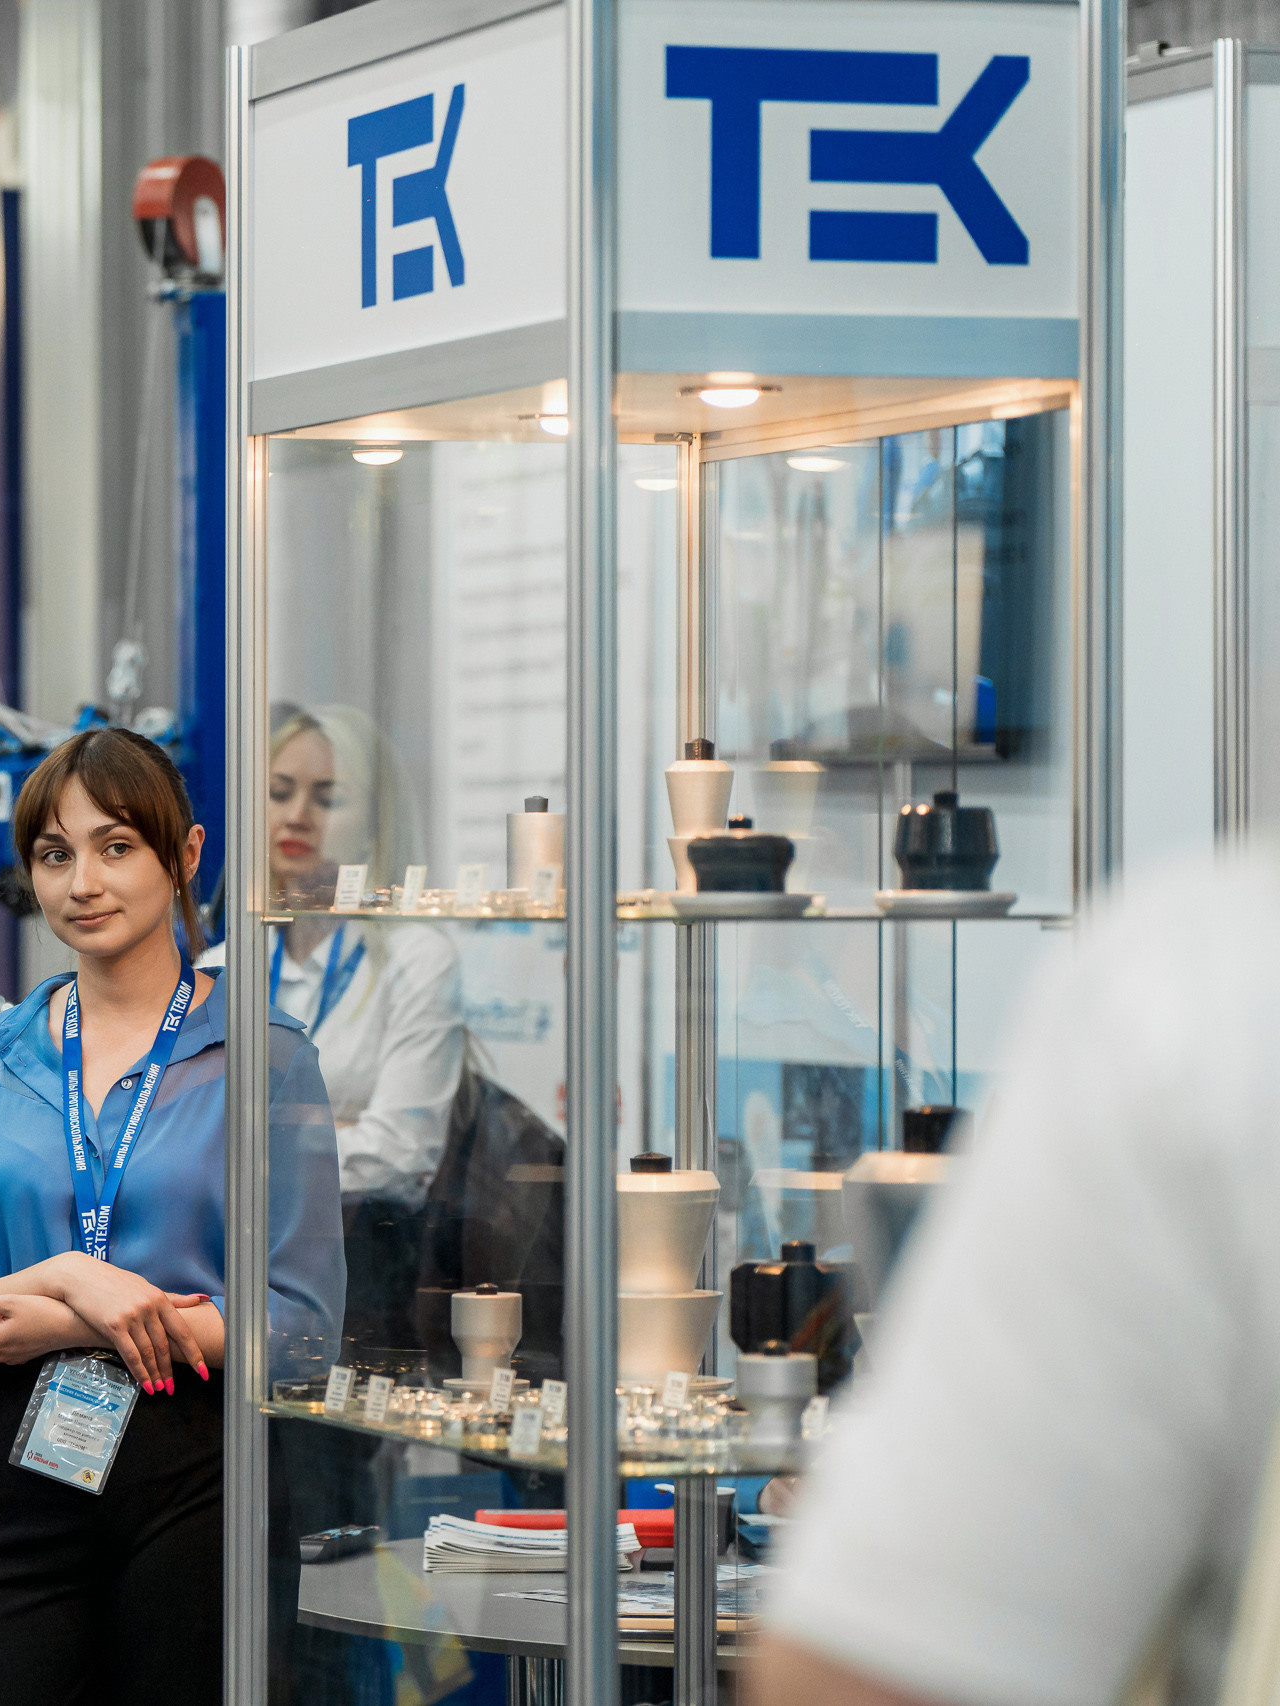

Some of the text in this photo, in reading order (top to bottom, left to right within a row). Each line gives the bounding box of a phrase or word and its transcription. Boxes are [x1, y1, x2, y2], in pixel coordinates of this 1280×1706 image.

[169, 980, 193, 1014] ТЕКОМ
[68, 1070, 87, 1171] ШИПЫ ПРОТИВОСКОЛЬЖЕНИЯ
[113, 1063, 161, 1169] ШИПЫ ПРОТИВОСКОЛЬЖЕНИЯ
[93, 1205, 111, 1261] ЕК ТЕКОМ
